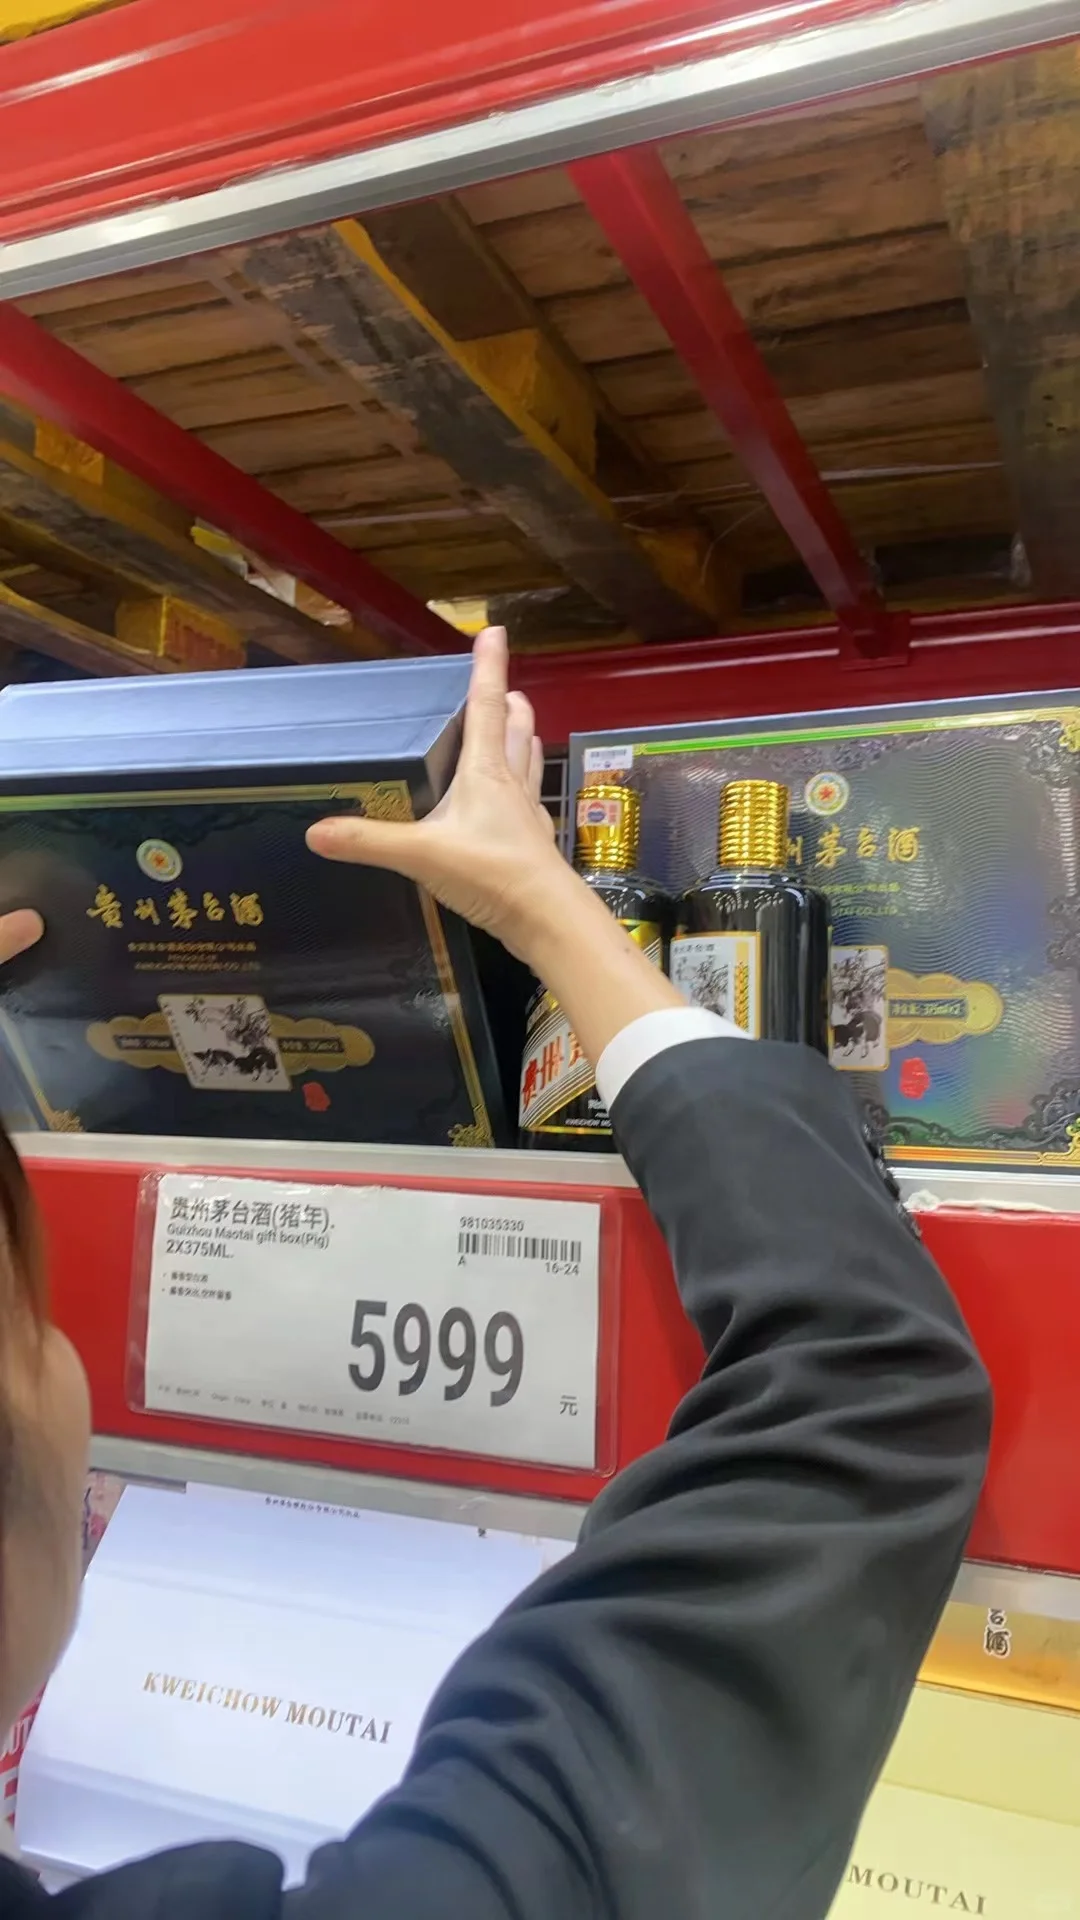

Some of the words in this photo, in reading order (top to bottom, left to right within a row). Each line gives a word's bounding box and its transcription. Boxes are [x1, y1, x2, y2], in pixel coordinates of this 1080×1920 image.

[86, 884, 264, 930] 贵州茅台酒
[166, 1223, 212, 1239] Guizhou
[215, 1226, 254, 1241] Maotai
[256, 1229, 277, 1245] gift
[279, 1230, 330, 1251] box(Pig)
[459, 1216, 525, 1232] 981035330
[457, 1255, 467, 1267] A
[545, 1262, 580, 1276] 16-24
[348, 1299, 525, 1408] 5999
[559, 1395, 578, 1416] 元
[143, 1671, 282, 1719] KWEICHOW
[285, 1701, 392, 1744] MOUTAI
[848, 1864, 987, 1916] MOUTAI
